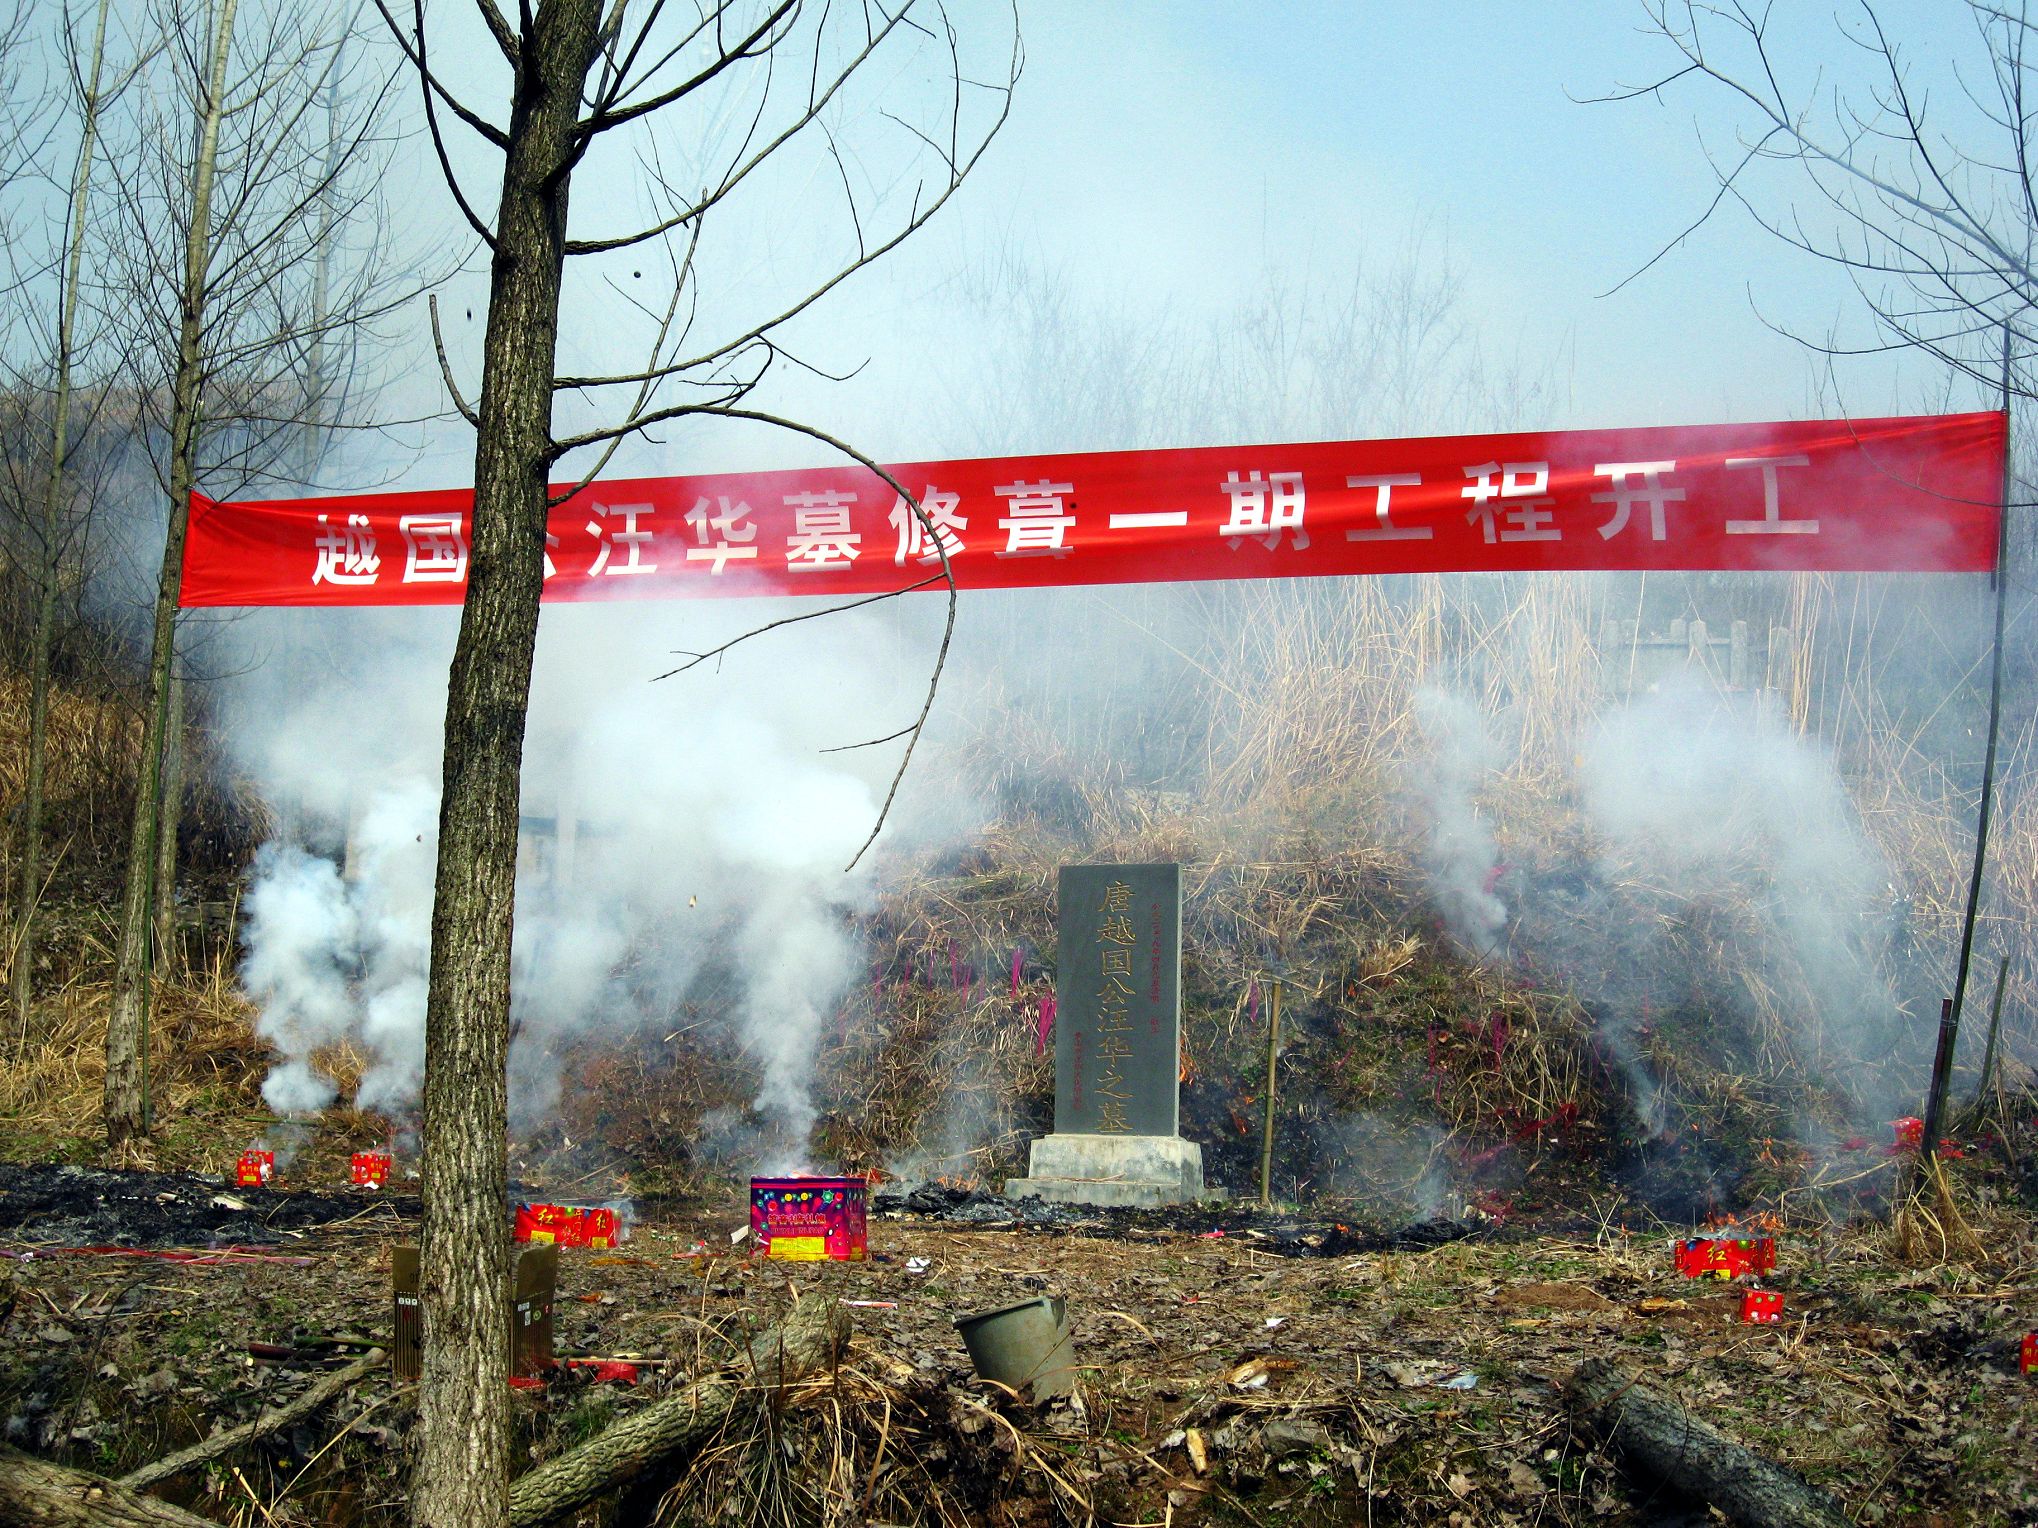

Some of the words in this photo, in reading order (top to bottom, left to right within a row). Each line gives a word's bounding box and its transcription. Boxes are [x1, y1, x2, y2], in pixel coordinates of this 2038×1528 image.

[312, 454, 1820, 586] 越国汪华墓修葺一期工程开工
[1095, 880, 1137, 1133] 唐越国公汪华之墓
